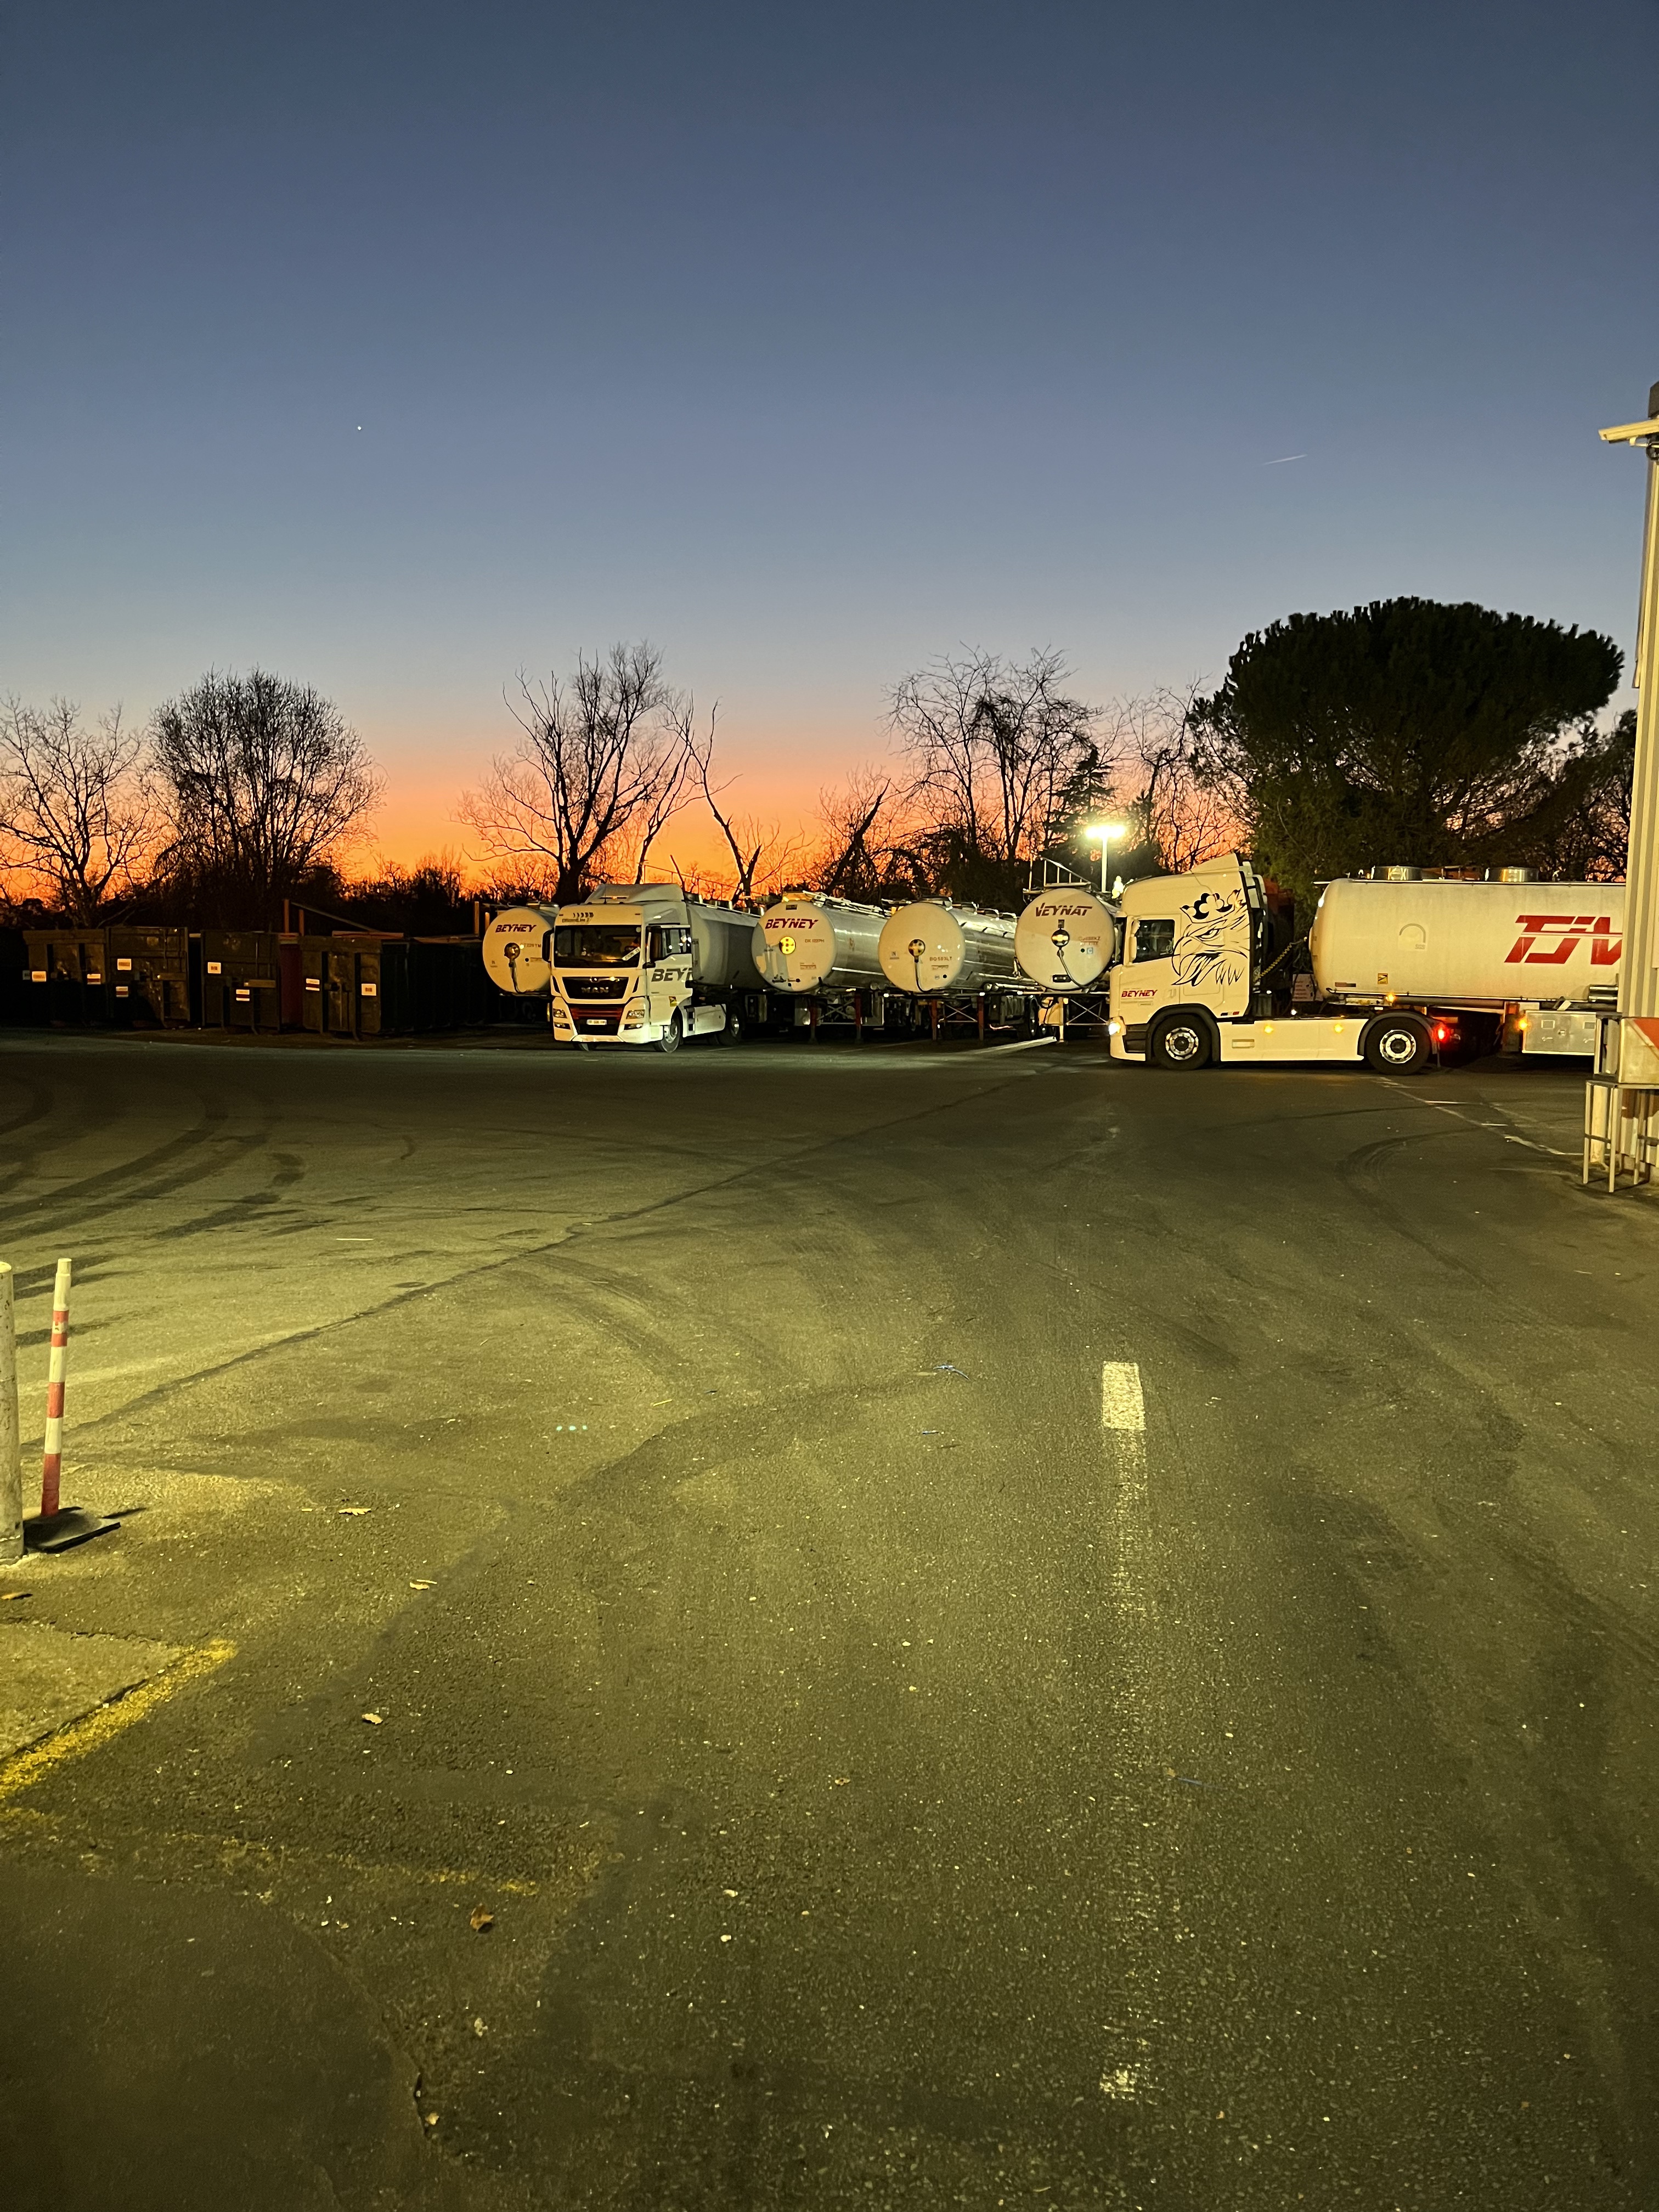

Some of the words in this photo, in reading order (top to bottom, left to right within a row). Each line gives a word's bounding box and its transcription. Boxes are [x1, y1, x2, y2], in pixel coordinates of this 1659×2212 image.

[1036, 902, 1093, 917] VEYNAT
[495, 924, 537, 933] BEYNEY
[765, 918, 819, 929] BEYNEY
[1121, 989, 1158, 997] BEYNEY
